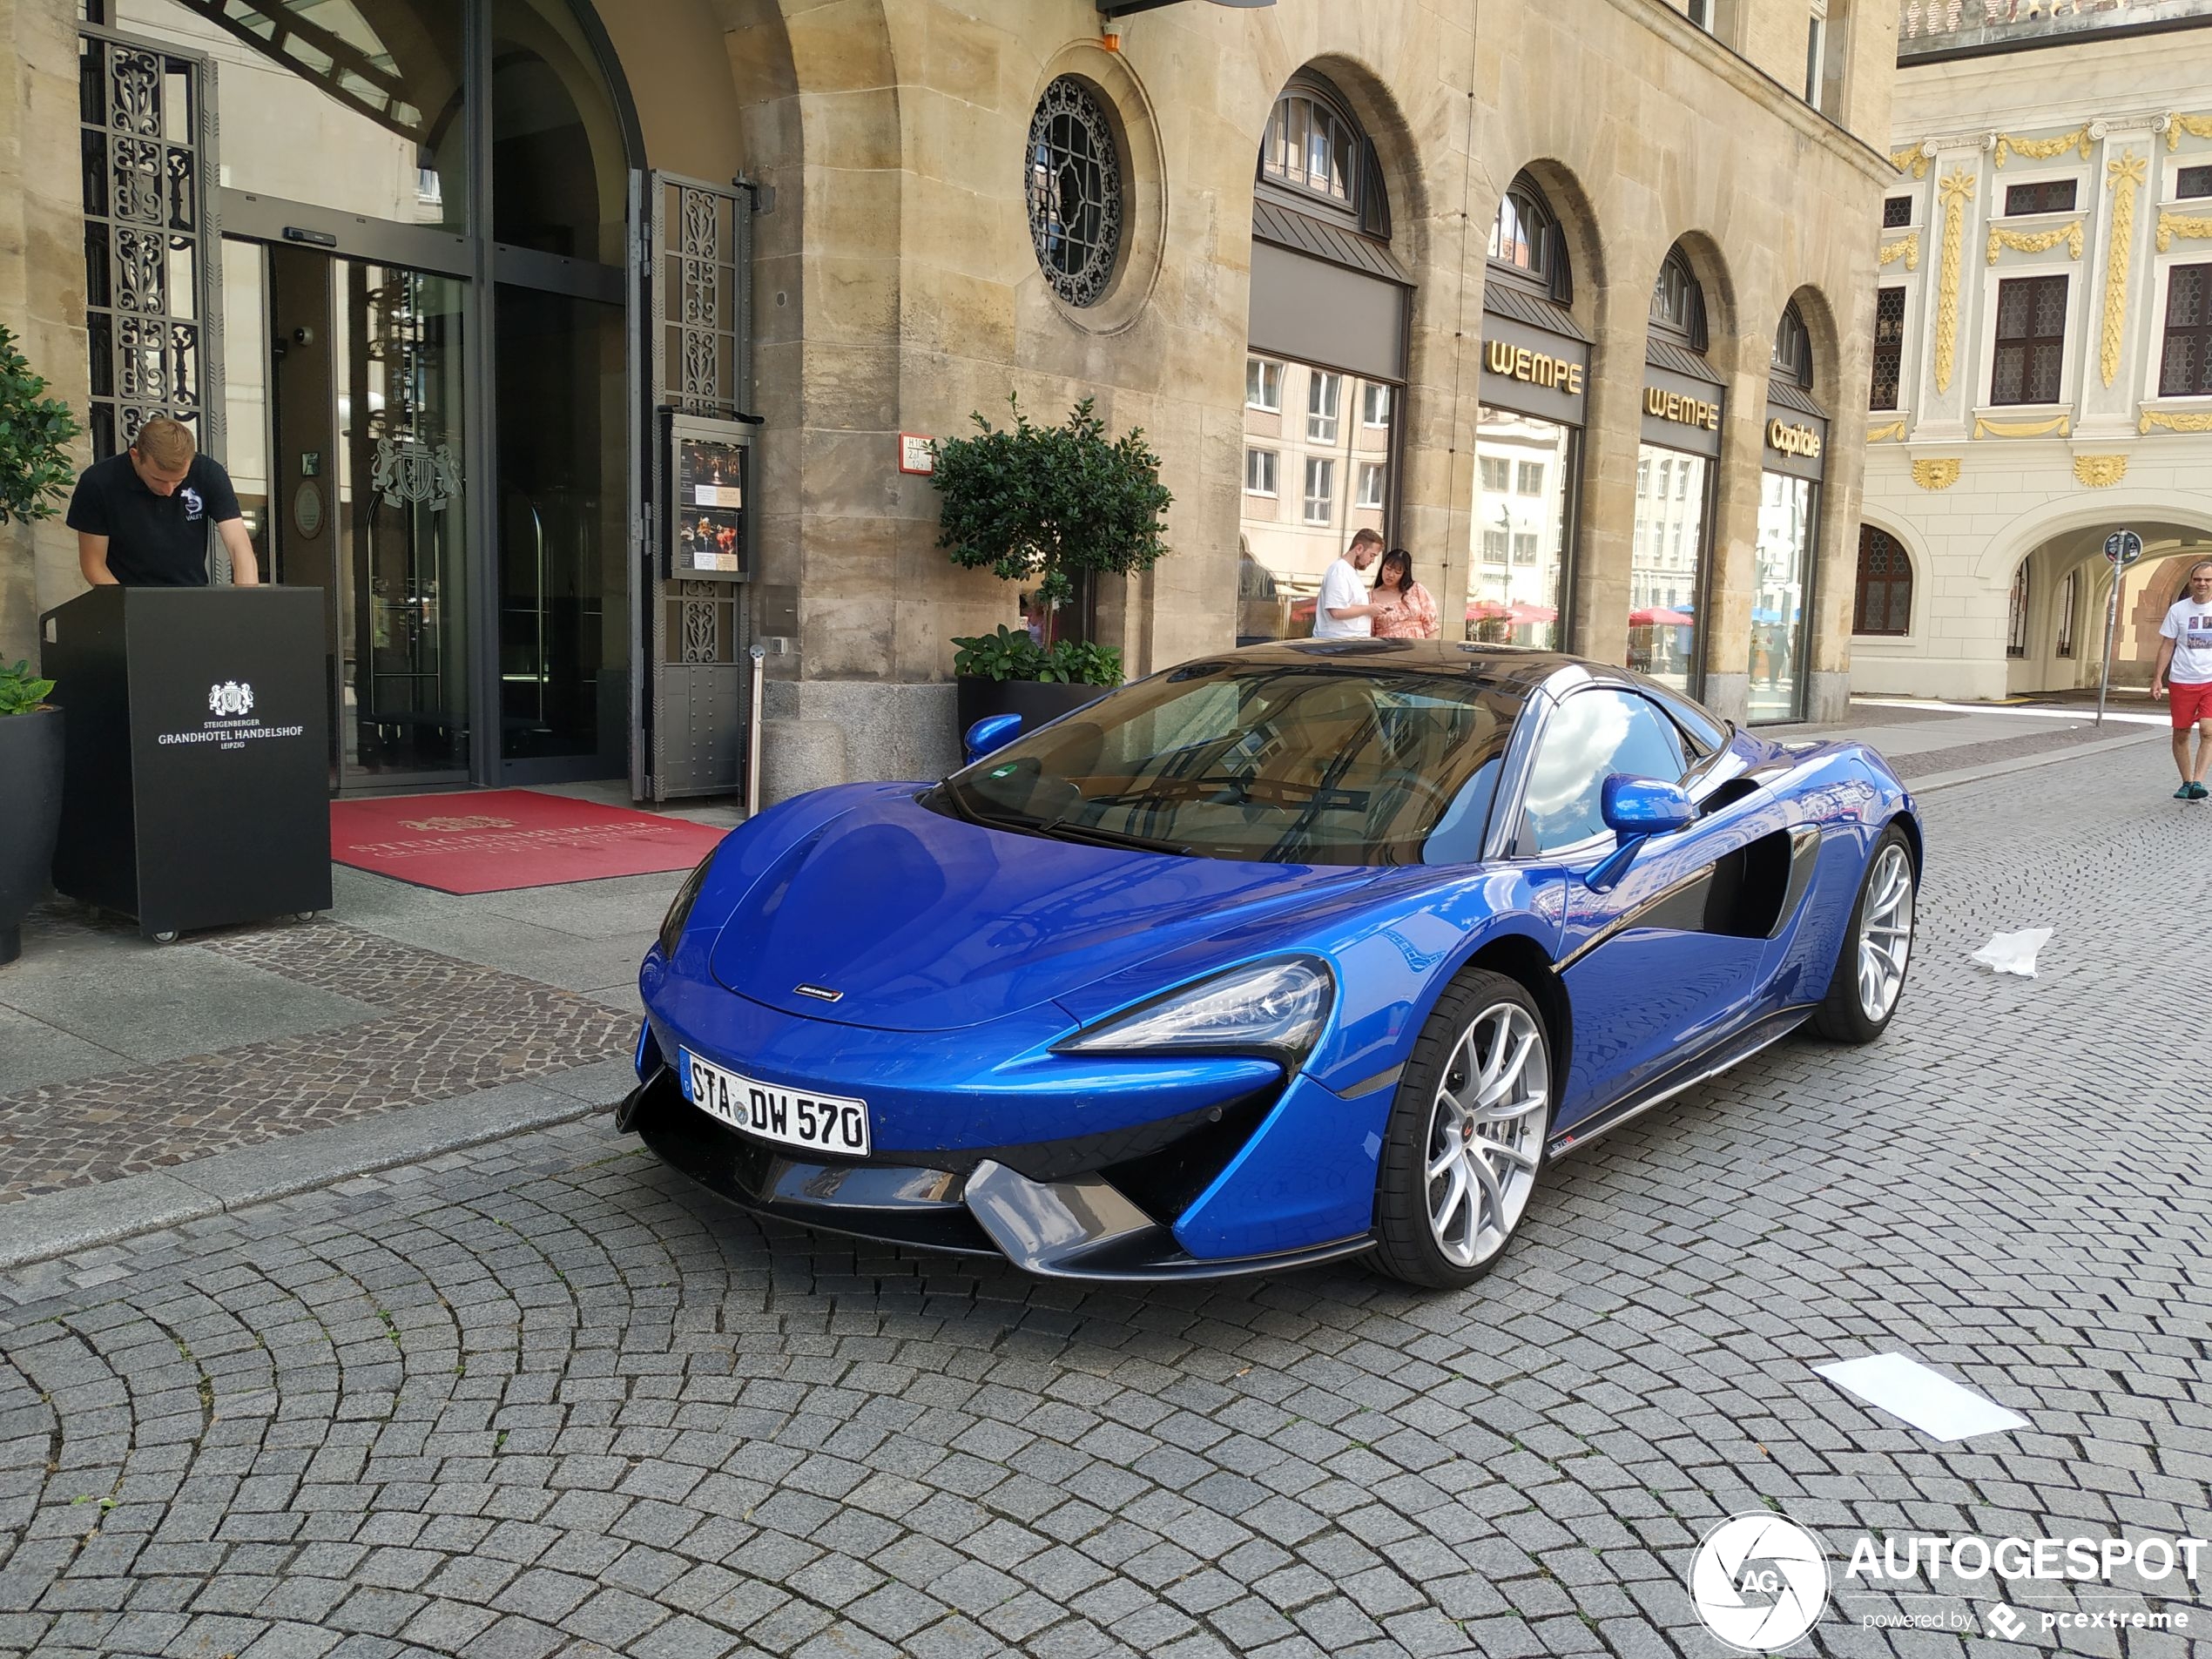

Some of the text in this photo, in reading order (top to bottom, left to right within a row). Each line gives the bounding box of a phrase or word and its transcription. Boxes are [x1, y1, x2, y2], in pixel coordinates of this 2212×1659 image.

[1489, 340, 1583, 395] WEMPE
[1648, 387, 1719, 431] WEMPE
[1770, 417, 1821, 458] Capitale
[158, 726, 303, 745] GRANDHOTEL HANDELSHOF
[204, 719, 260, 729] STEIGENBERGER
[220, 741, 246, 750] LEIPZIG
[348, 822, 659, 853] STEIGENBERGER
[692, 1062, 863, 1147] STA DW 570
